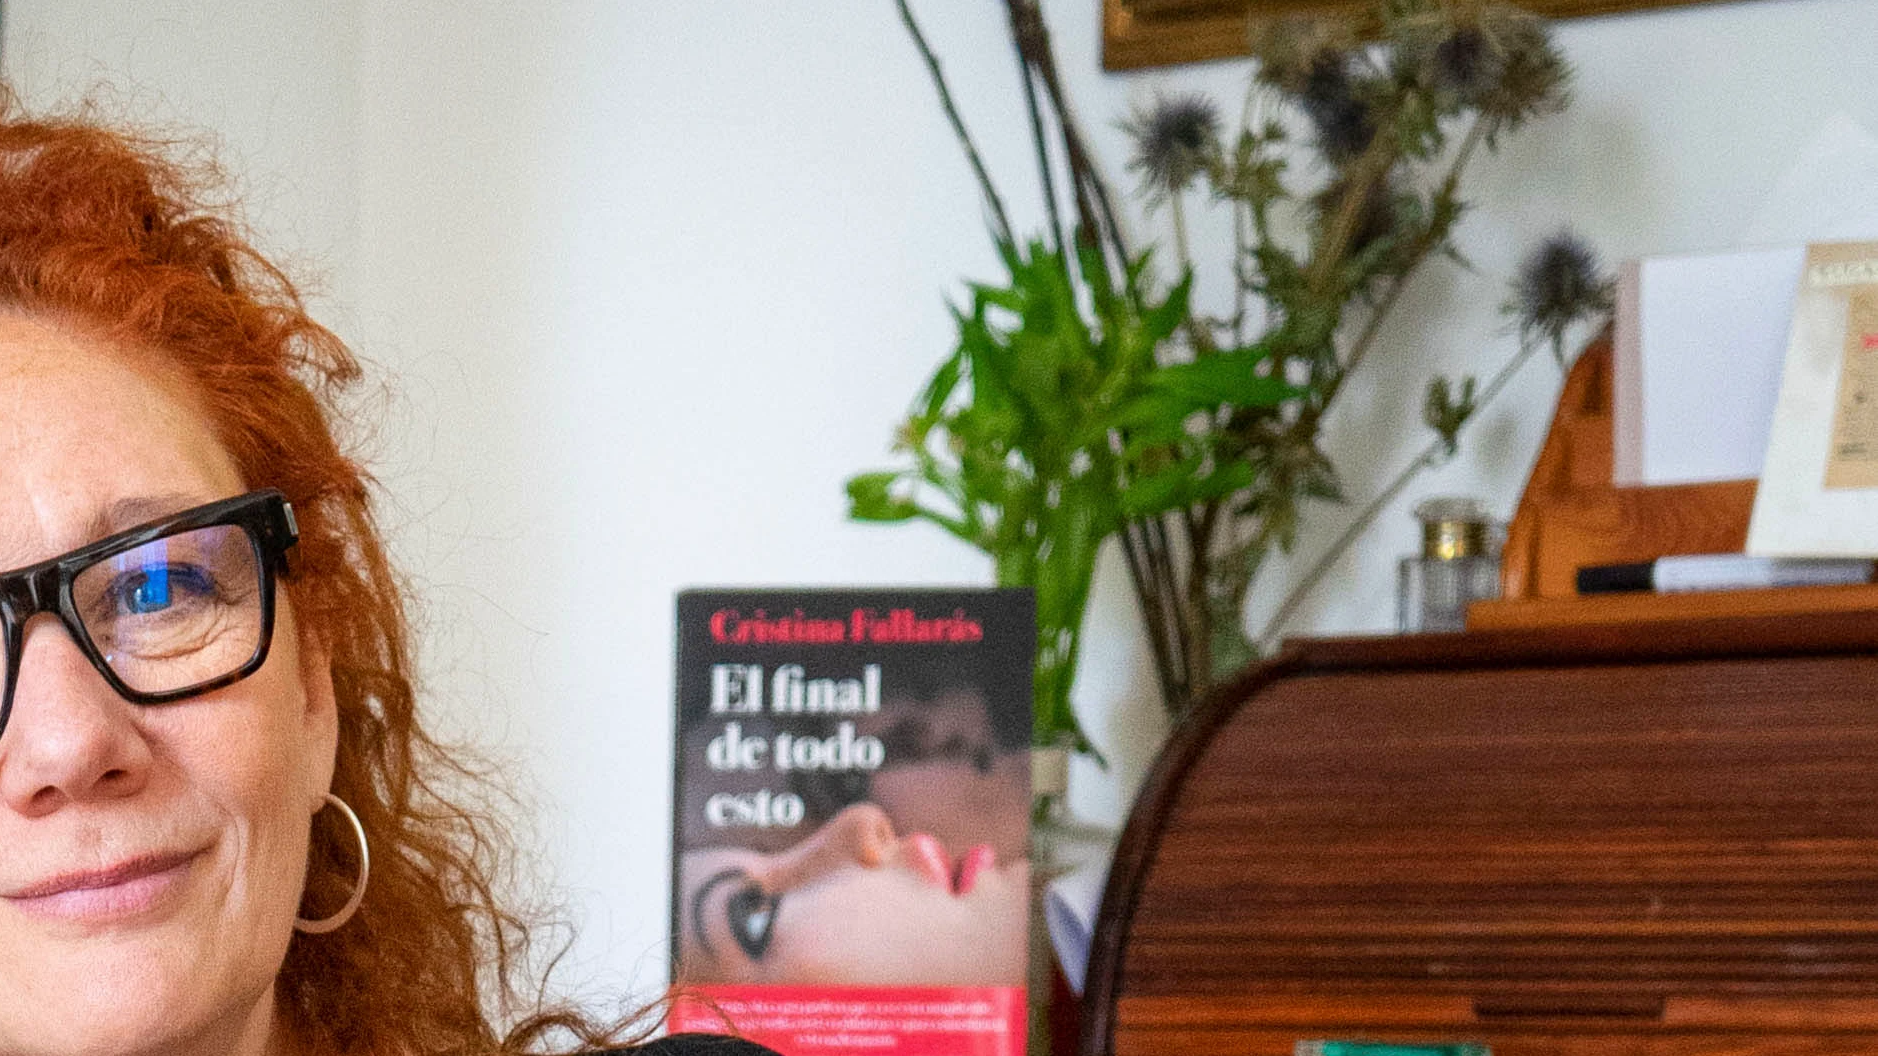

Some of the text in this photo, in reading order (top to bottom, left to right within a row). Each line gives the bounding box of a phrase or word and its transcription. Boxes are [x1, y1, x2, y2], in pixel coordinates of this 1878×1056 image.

[710, 608, 983, 643] Cristina Fallarás
[711, 664, 881, 714] El final
[707, 721, 885, 769] de todo
[706, 789, 805, 826] esto
